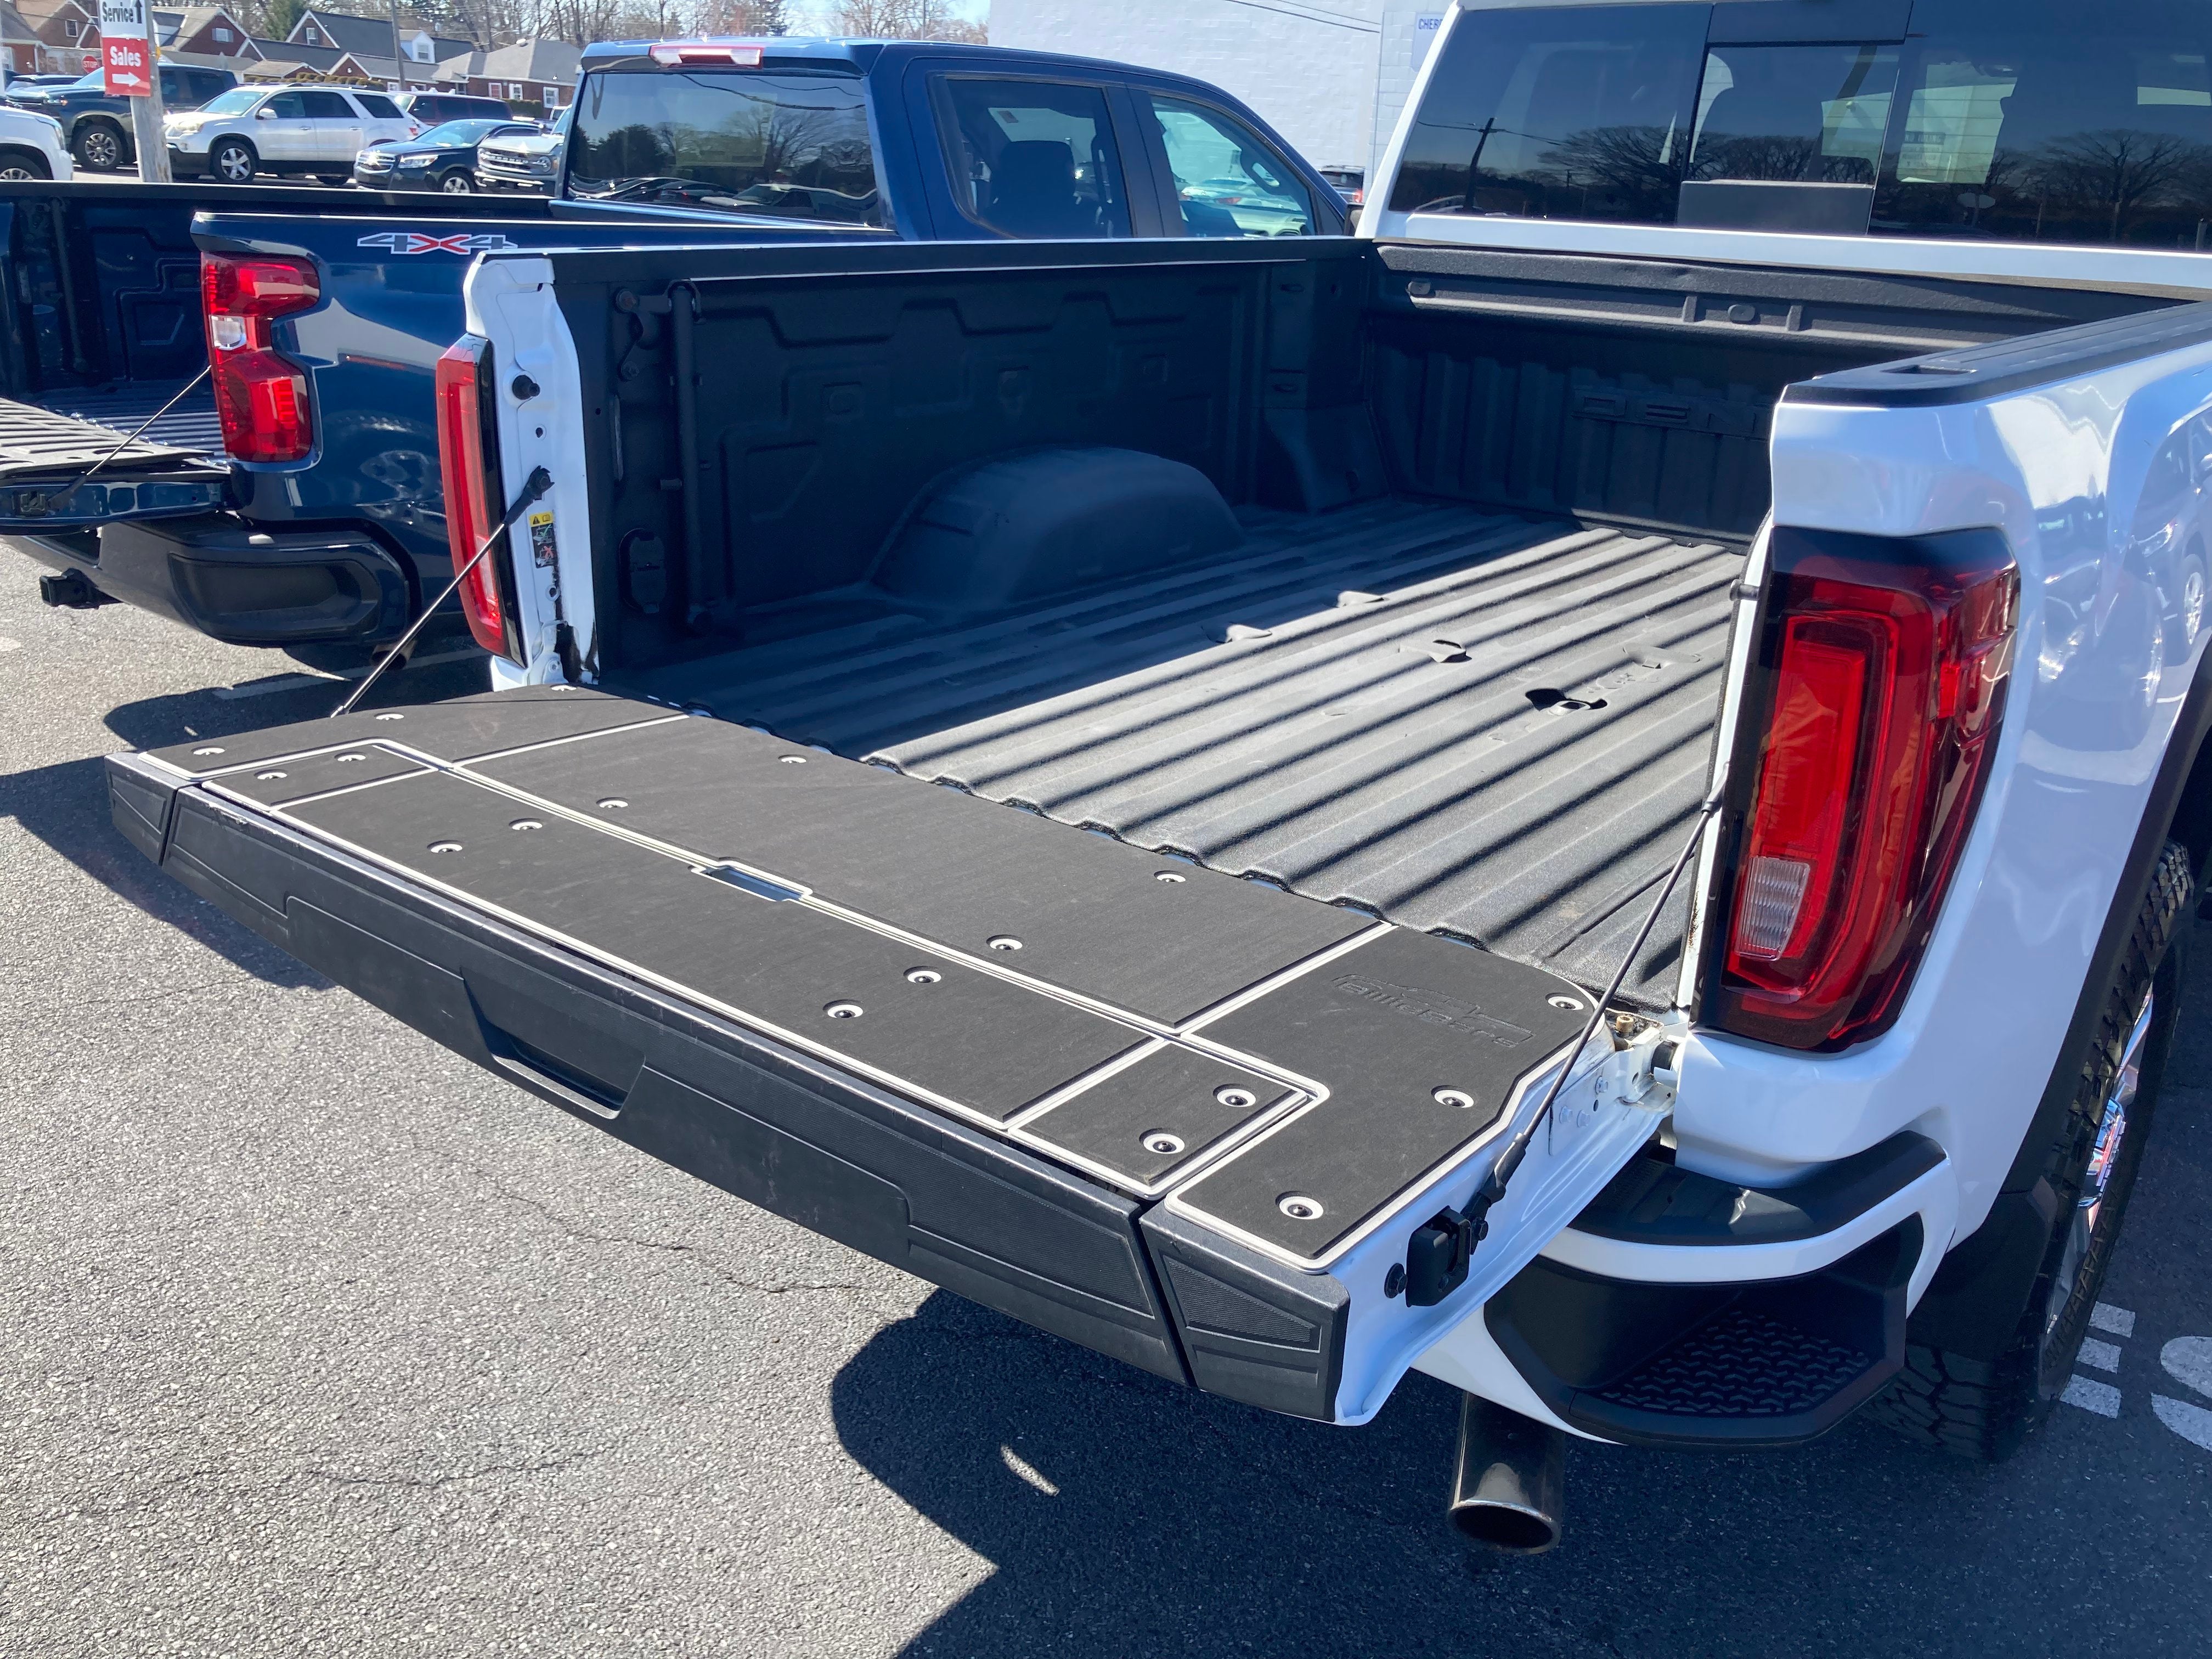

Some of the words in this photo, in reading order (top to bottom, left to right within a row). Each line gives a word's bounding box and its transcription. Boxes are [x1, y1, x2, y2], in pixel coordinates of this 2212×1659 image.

[102, 1, 133, 22] Service
[83, 60, 98, 69] STOP
[110, 46, 142, 67] Sales
